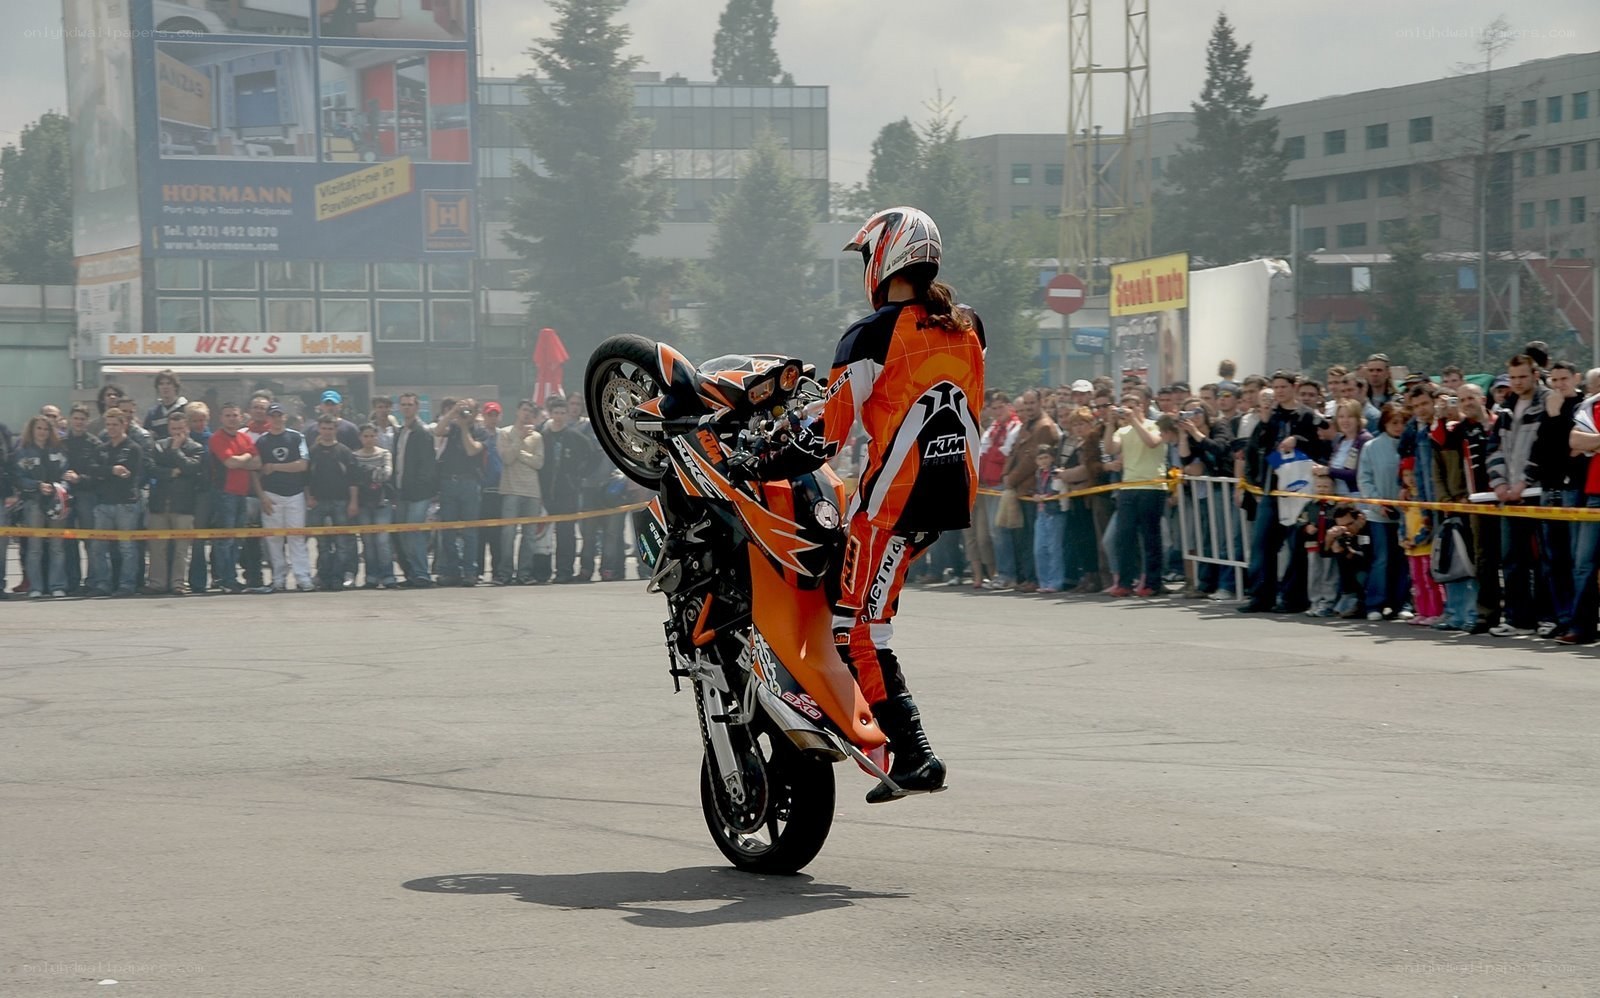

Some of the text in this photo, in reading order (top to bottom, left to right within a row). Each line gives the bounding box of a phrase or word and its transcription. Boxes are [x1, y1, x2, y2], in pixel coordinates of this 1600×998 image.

[108, 335, 176, 355] Fast Food
[301, 334, 363, 354] Fast Food
[696, 429, 723, 465] KTM
[924, 433, 967, 459] KTM
[671, 435, 723, 499] DUKE
